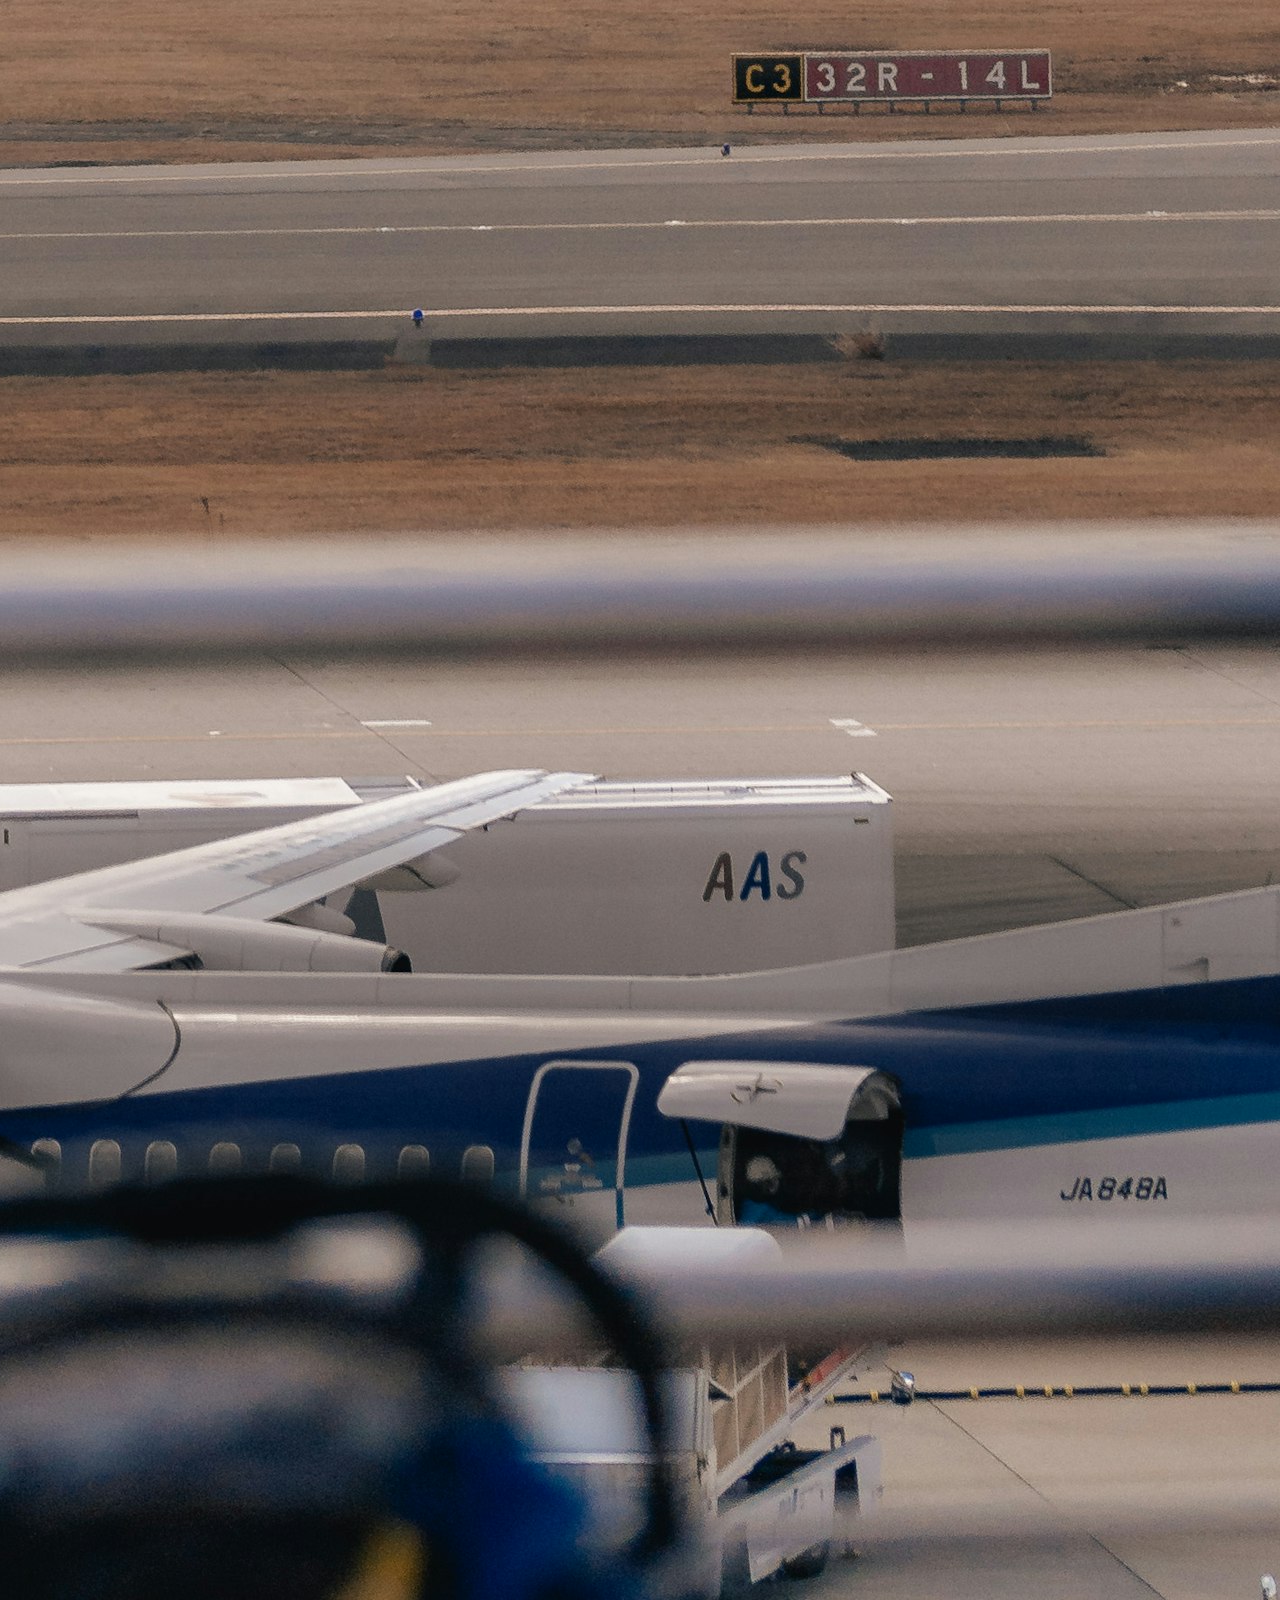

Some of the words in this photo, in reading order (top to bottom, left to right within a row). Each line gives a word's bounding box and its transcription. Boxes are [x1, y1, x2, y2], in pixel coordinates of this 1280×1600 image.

[745, 63, 792, 93] C3
[702, 850, 808, 902] AAS
[1060, 1176, 1168, 1201] JA848A
